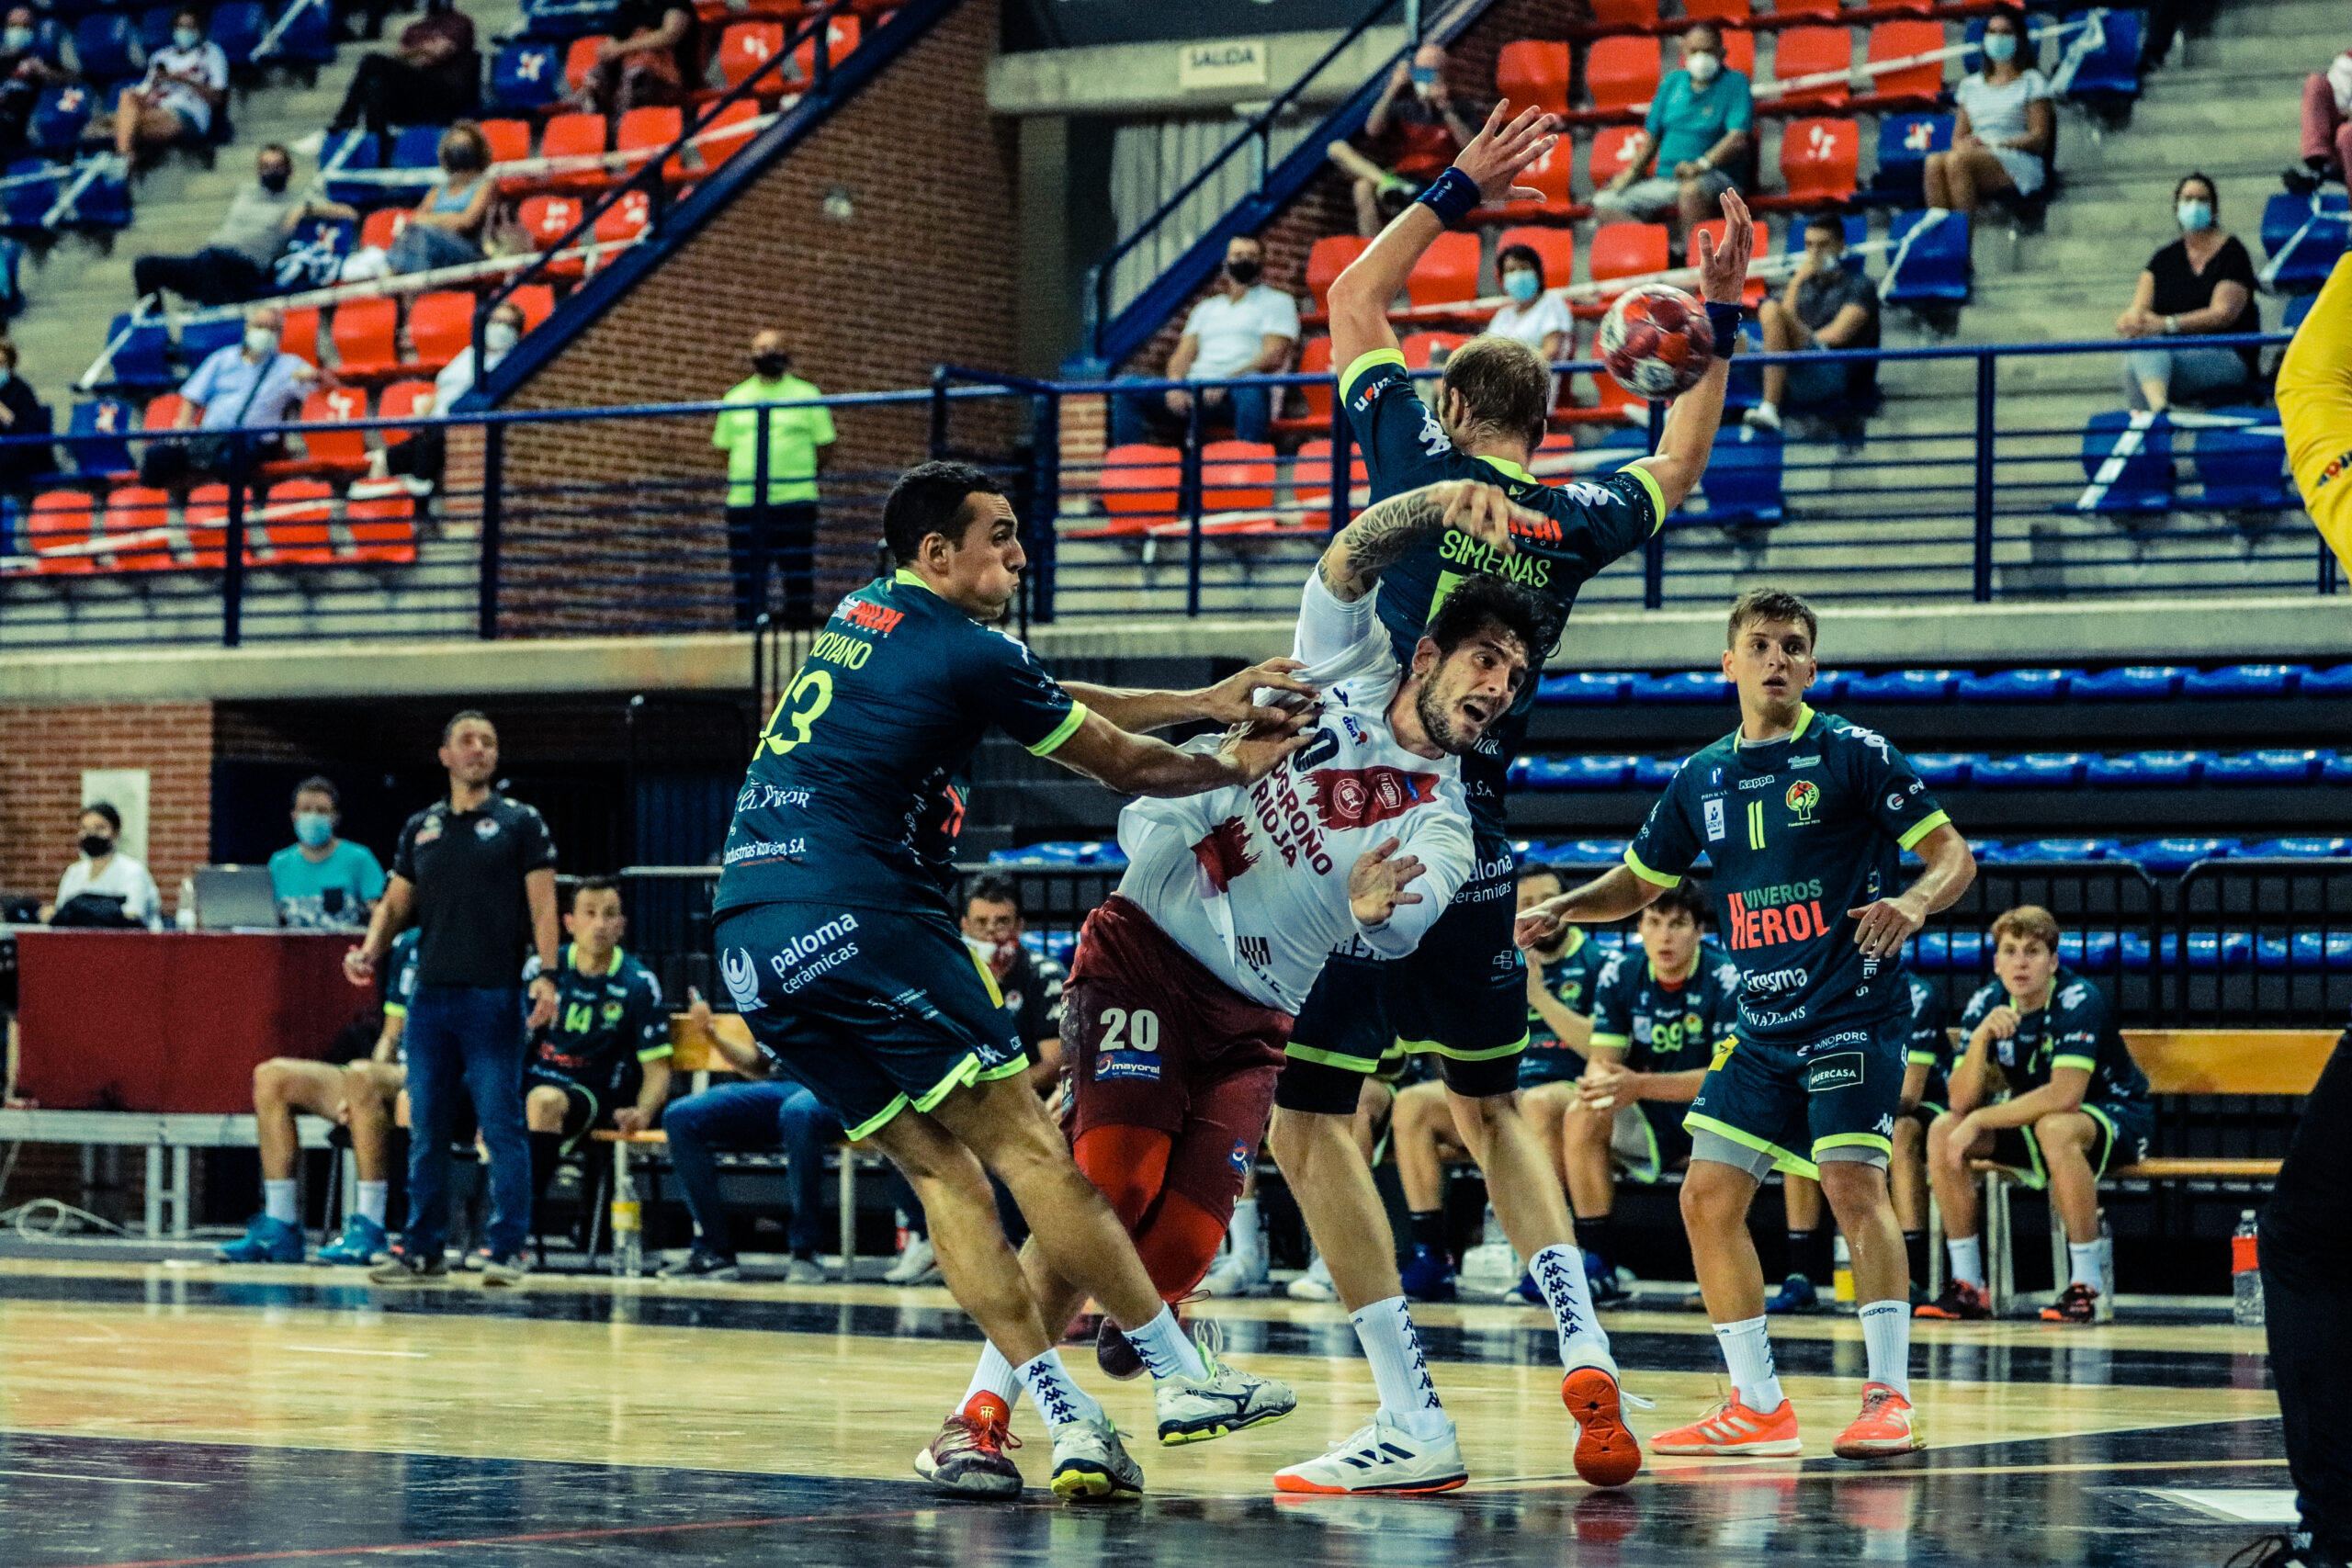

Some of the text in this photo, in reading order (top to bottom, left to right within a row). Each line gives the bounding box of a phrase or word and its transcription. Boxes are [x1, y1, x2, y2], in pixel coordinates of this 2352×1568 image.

[1439, 529, 1552, 588] SIMENAS
[1738, 774, 1776, 790] Kappa
[1250, 777, 1297, 869] RIOJA
[1270, 761, 1333, 876] OGROÑO
[1747, 799, 1766, 851] 11
[1742, 878, 1824, 909] VIVEROS
[770, 912, 859, 977] paloma
[1727, 891, 1831, 951] HEROL
[782, 940, 860, 995] cerámicas
[1099, 1007, 1159, 1052] 20
[1651, 1021, 1684, 1054] 99
[1813, 1032, 1868, 1051] INNOPORC
[1112, 1063, 1160, 1074] mayoral
[1811, 1068, 1857, 1085] HUERCASA
